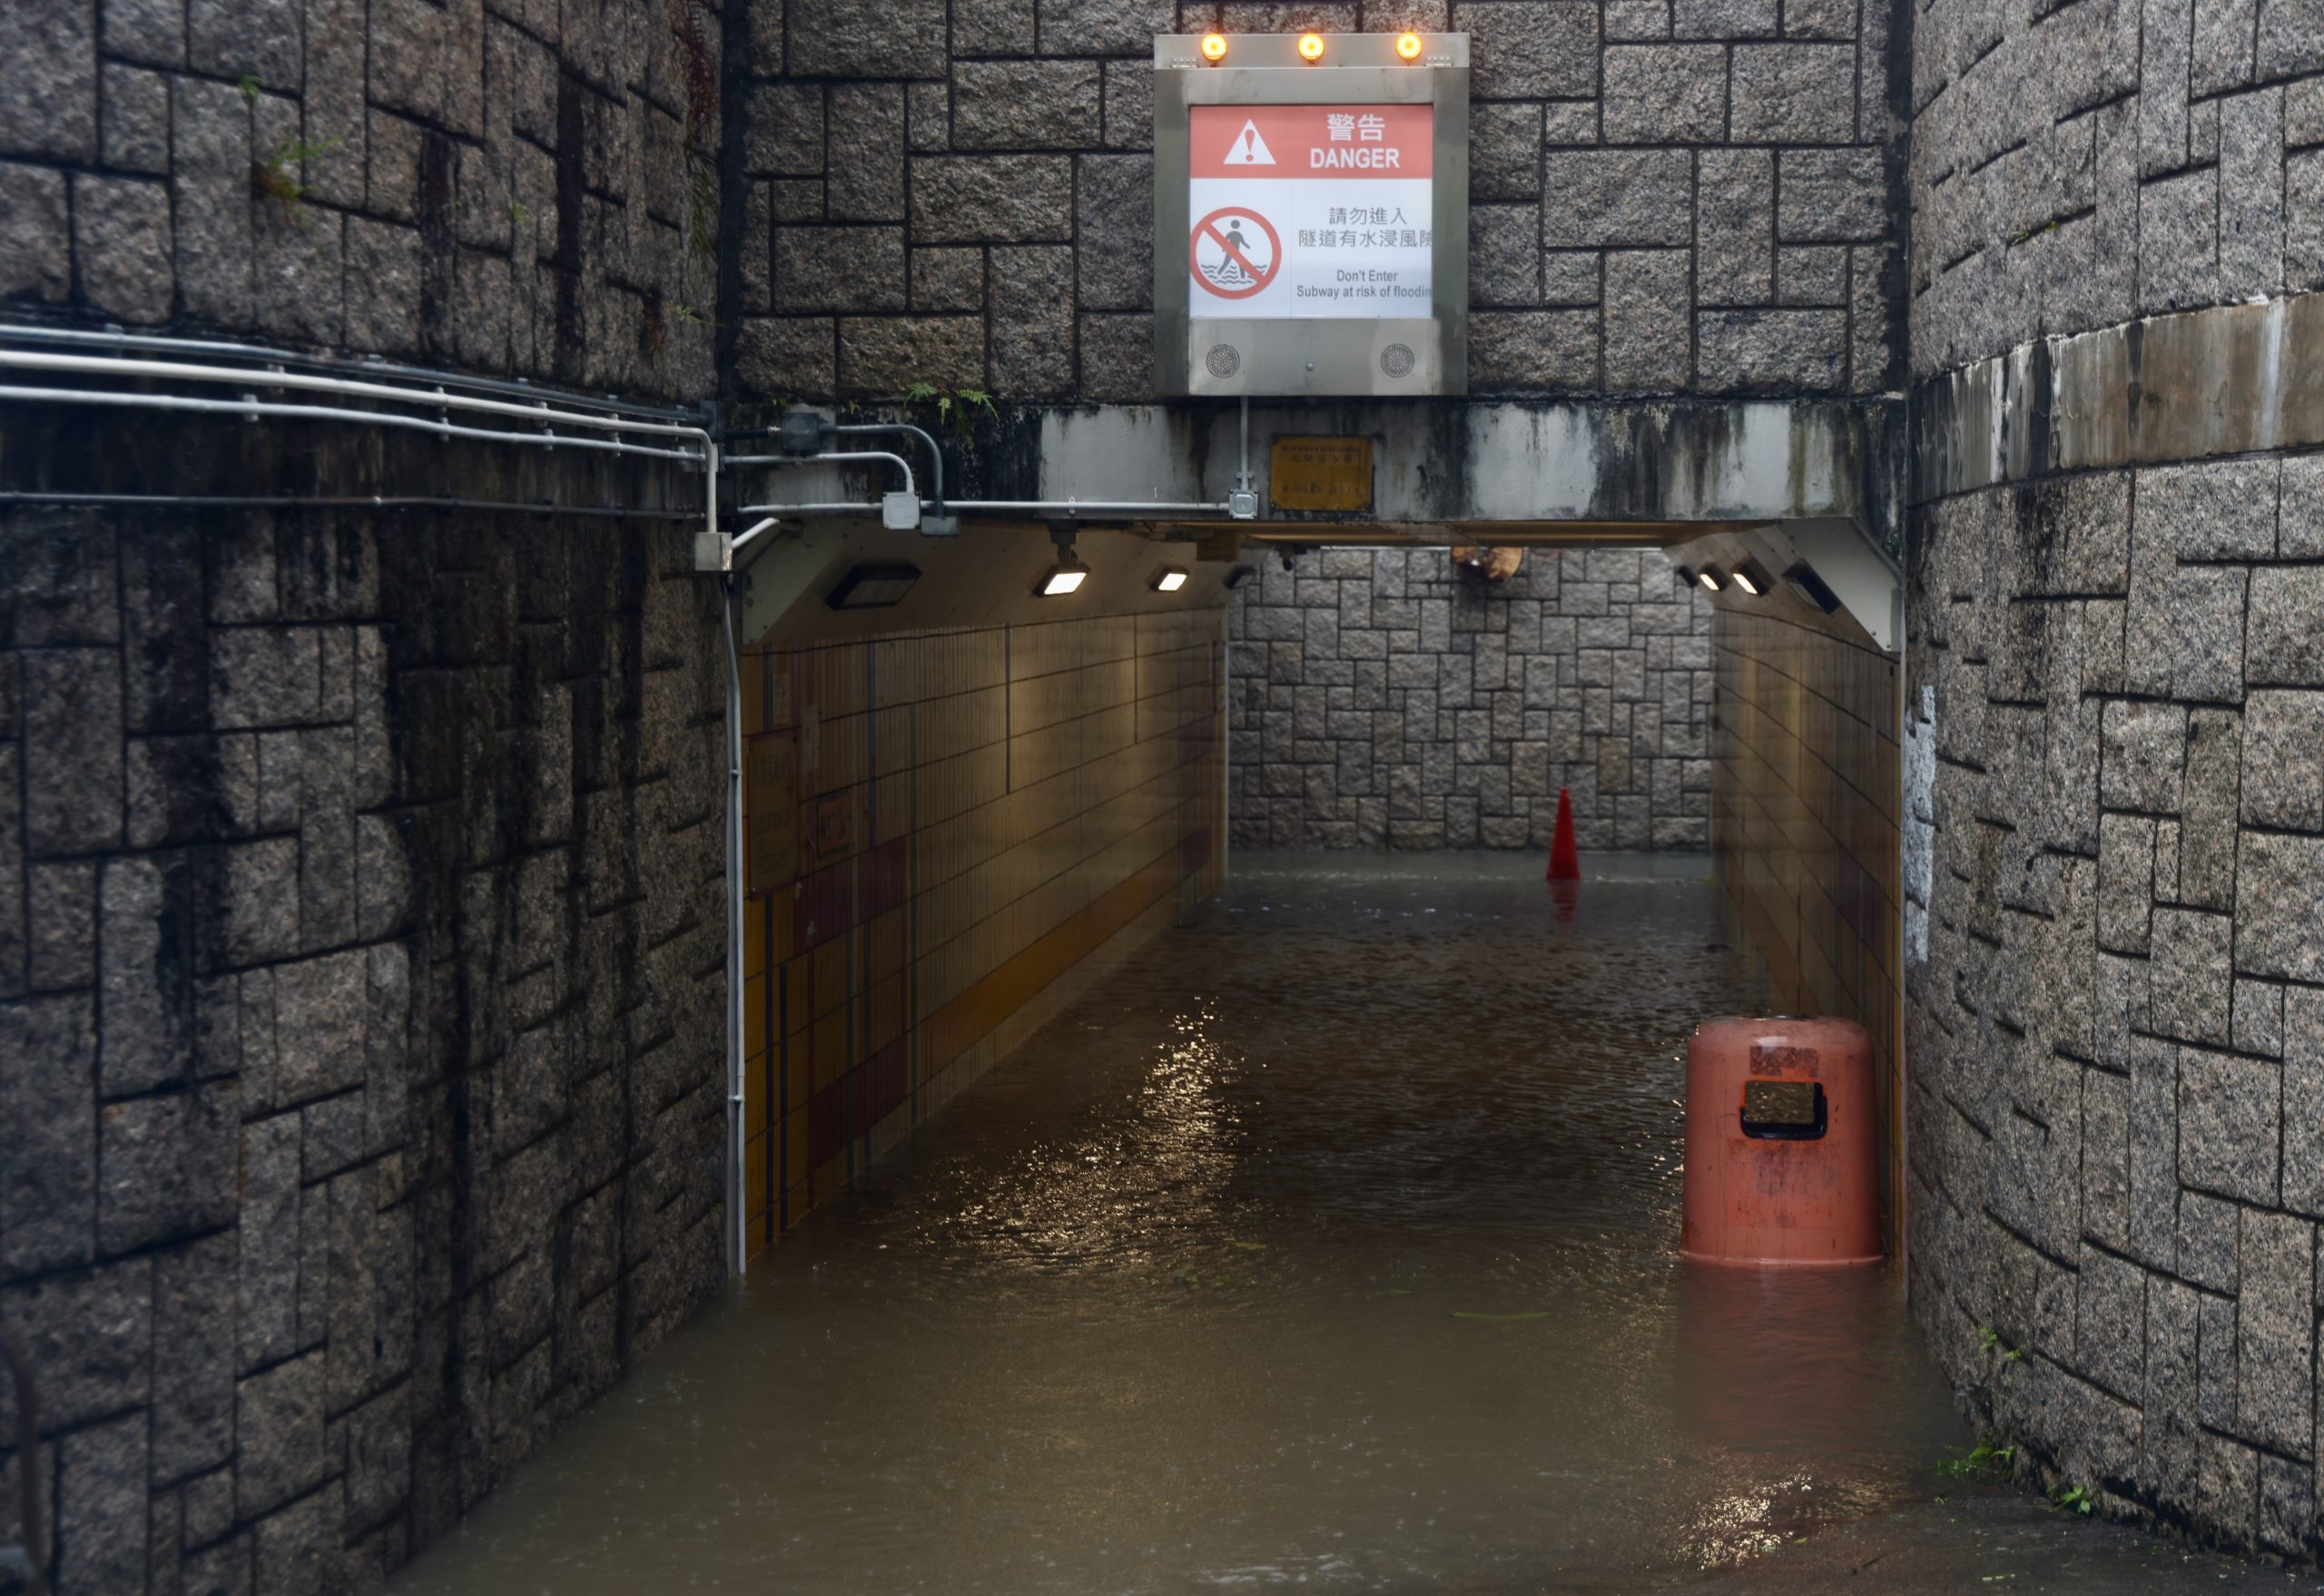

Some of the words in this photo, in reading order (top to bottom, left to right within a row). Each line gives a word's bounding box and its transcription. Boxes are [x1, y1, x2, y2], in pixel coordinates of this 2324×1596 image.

[1327, 113, 1385, 142] 警告
[1310, 147, 1401, 169] DANGER
[1329, 207, 1408, 225] 請勿進入
[1336, 270, 1365, 282] Don't
[1368, 270, 1398, 282] Enter
[1296, 284, 1339, 300] Subway
[1343, 285, 1353, 298] at
[1356, 284, 1376, 298] risk
[1379, 284, 1391, 298] of
